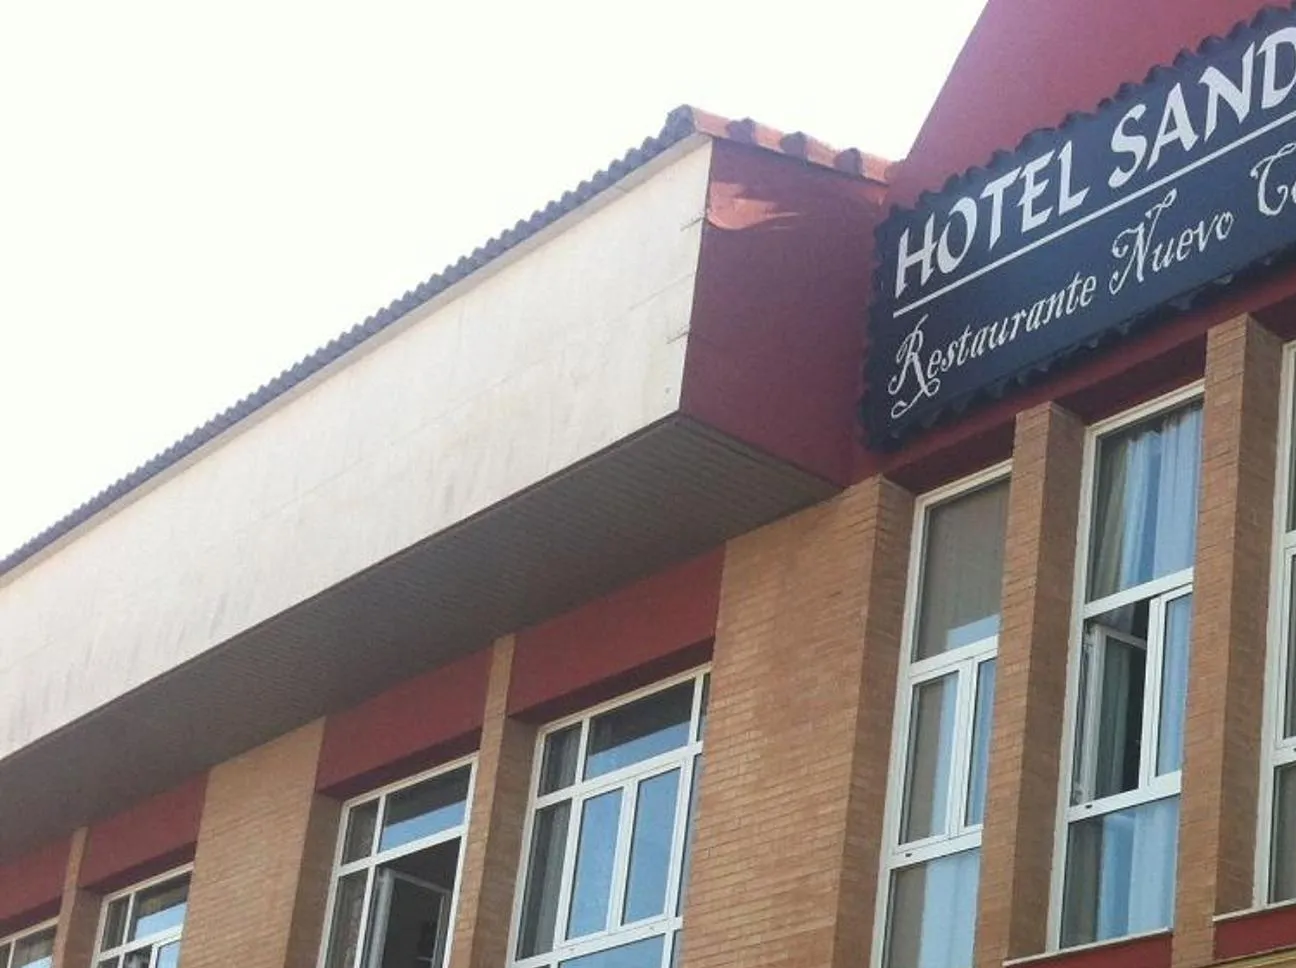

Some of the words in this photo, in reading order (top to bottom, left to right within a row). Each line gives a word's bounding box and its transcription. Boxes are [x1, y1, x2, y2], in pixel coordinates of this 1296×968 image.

[888, 271, 1097, 419] Restaurante
[1109, 189, 1234, 295] Nuevo
[895, 141, 1091, 299] HOTEL
